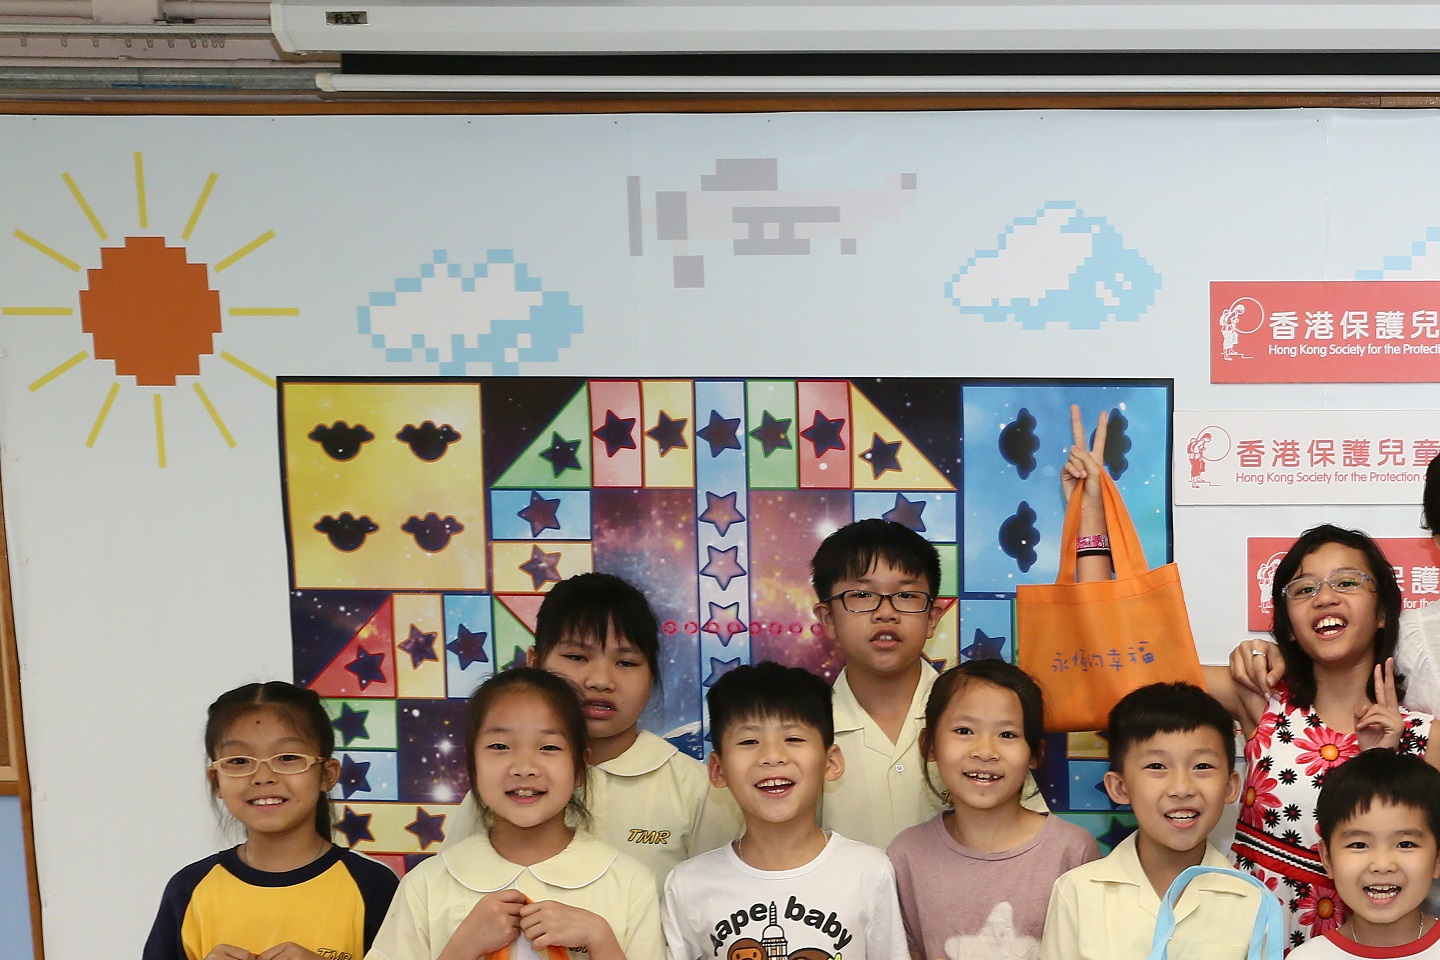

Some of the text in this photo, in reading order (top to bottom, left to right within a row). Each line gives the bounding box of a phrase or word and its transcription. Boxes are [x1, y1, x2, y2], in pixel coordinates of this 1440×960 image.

[1268, 344, 1297, 357] Hong
[1299, 344, 1327, 357] Kong
[1329, 343, 1365, 357] Society
[1367, 343, 1382, 355] for
[1384, 343, 1401, 355] the
[1236, 439, 1440, 468] 香港保護兒童
[1236, 472, 1264, 485] Hong
[1267, 472, 1294, 485] Kong
[1296, 472, 1332, 485] Society
[1334, 471, 1348, 482] for
[1351, 471, 1367, 482] the
[1370, 471, 1420, 482] Protection
[1403, 597, 1417, 609] for
[627, 828, 671, 844] TMR
[784, 895, 852, 951] baby
